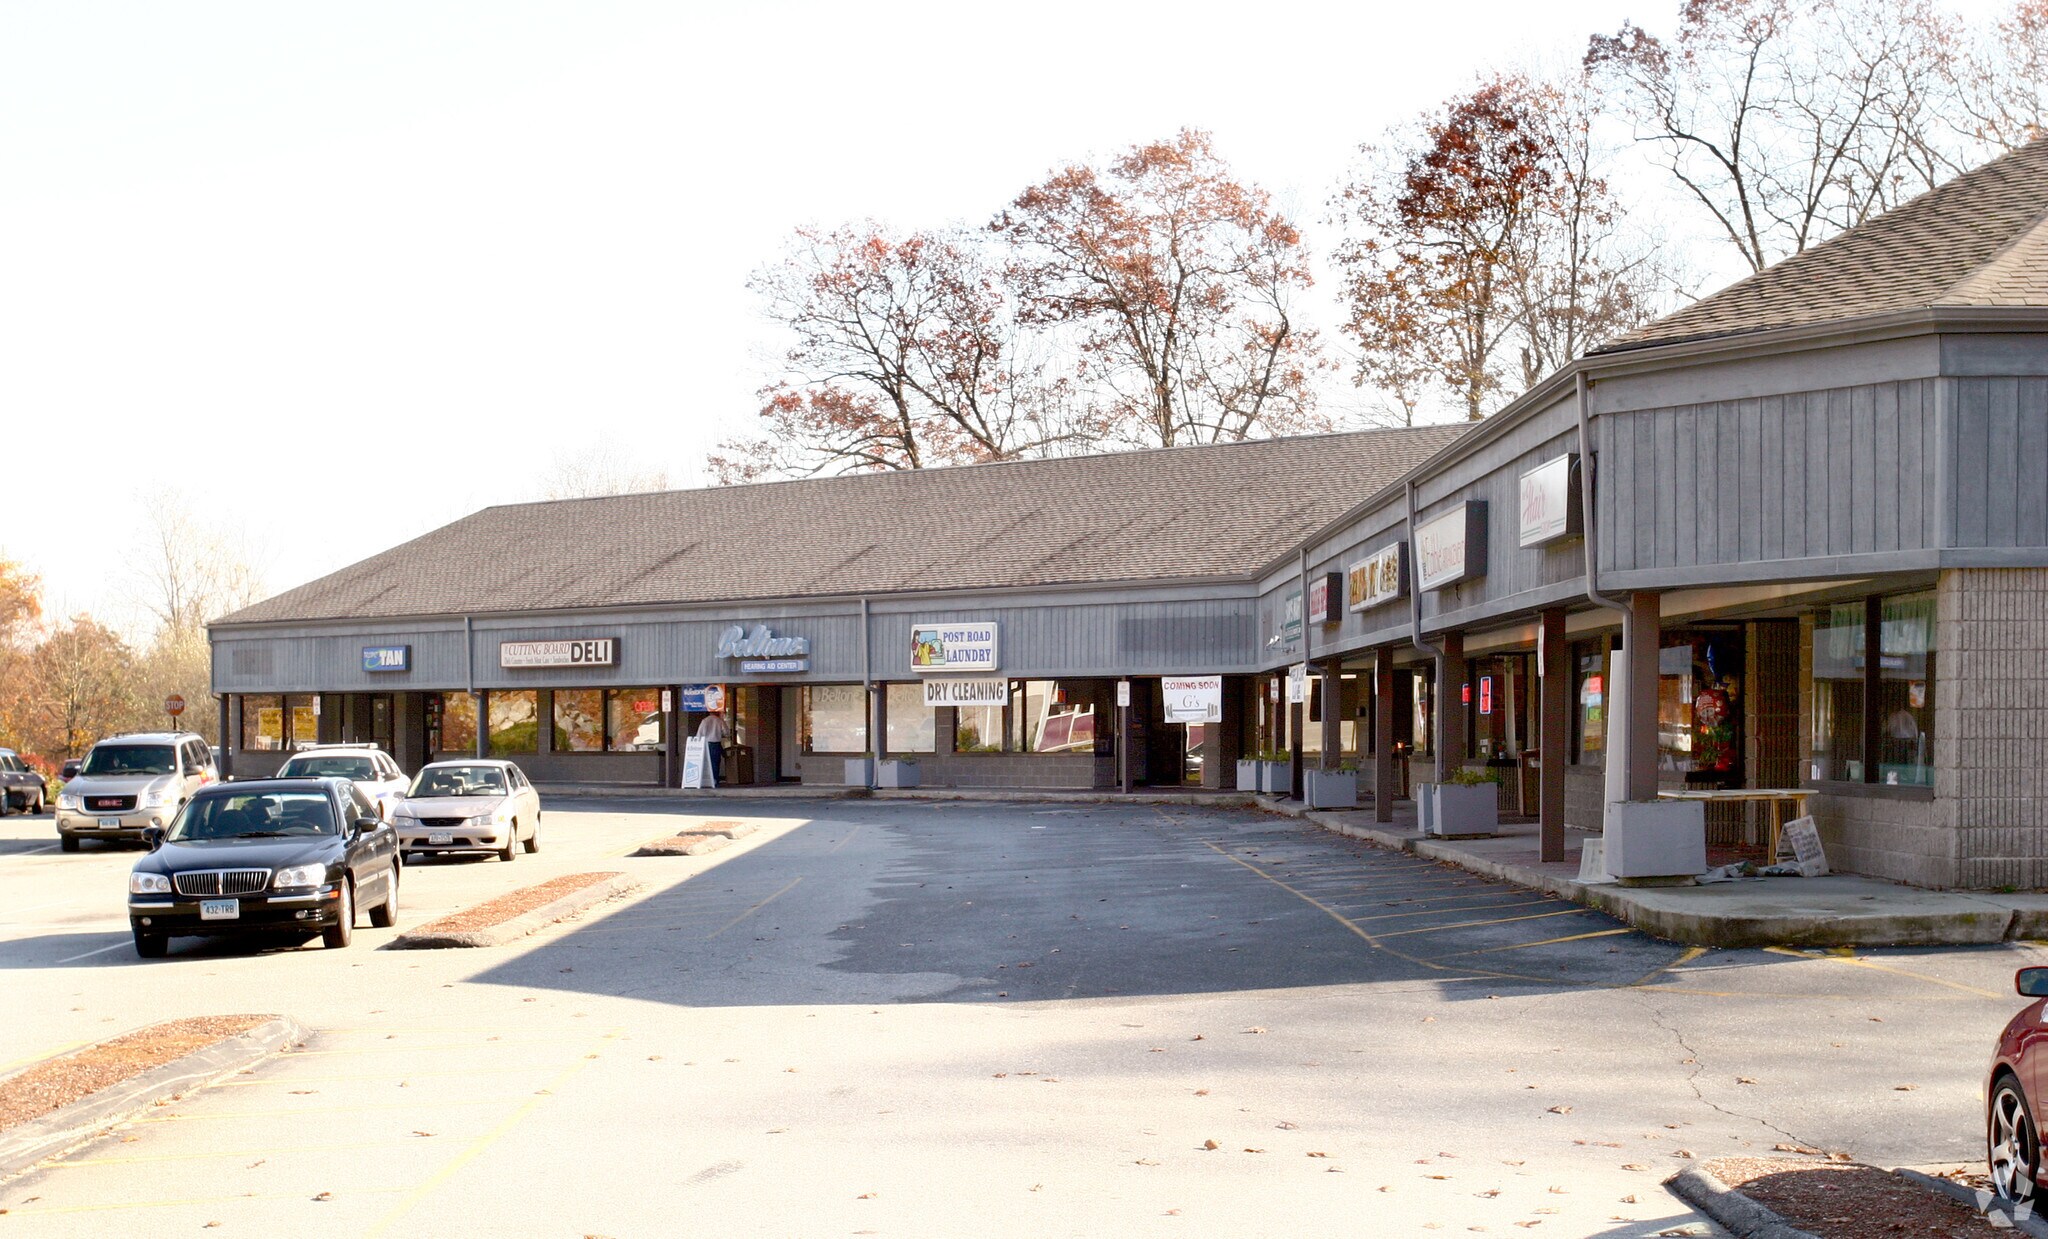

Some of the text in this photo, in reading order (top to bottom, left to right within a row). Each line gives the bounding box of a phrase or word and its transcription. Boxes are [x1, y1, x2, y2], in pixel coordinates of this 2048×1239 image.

[943, 631, 991, 642] POST ROAD
[379, 650, 403, 666] TAN
[508, 643, 541, 656] CUTTING
[543, 642, 570, 655] BOARD
[570, 641, 608, 662] DELI
[946, 648, 991, 662] LAUNDRY
[927, 681, 1004, 701] DRY CLEANING
[1164, 680, 1219, 690] COMING SOON
[165, 702, 184, 710] STOP
[1182, 694, 1200, 708] G's
